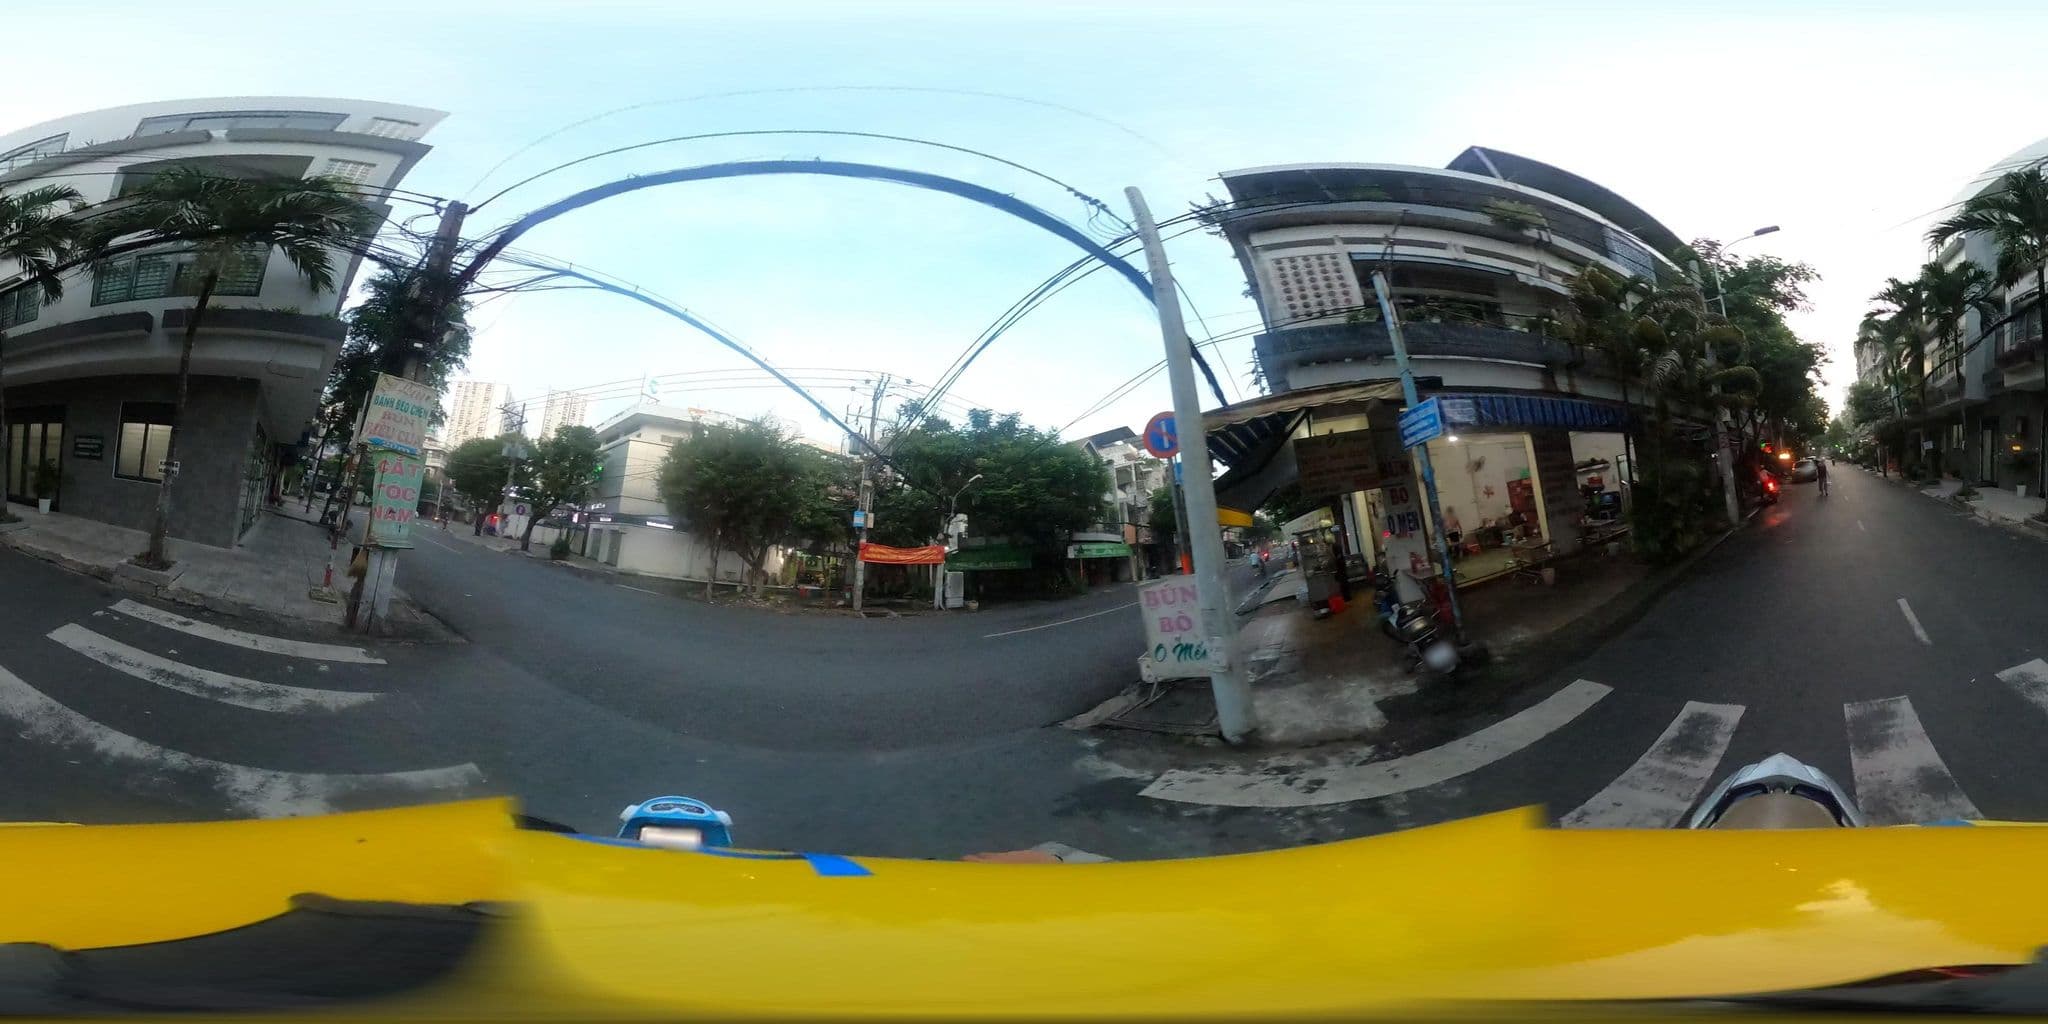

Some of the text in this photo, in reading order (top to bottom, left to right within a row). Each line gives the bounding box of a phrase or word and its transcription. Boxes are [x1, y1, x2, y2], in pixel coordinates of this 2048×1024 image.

[1144, 583, 1198, 607] BÚN
[1158, 609, 1194, 633] BÒ
[1153, 643, 1168, 663] O
